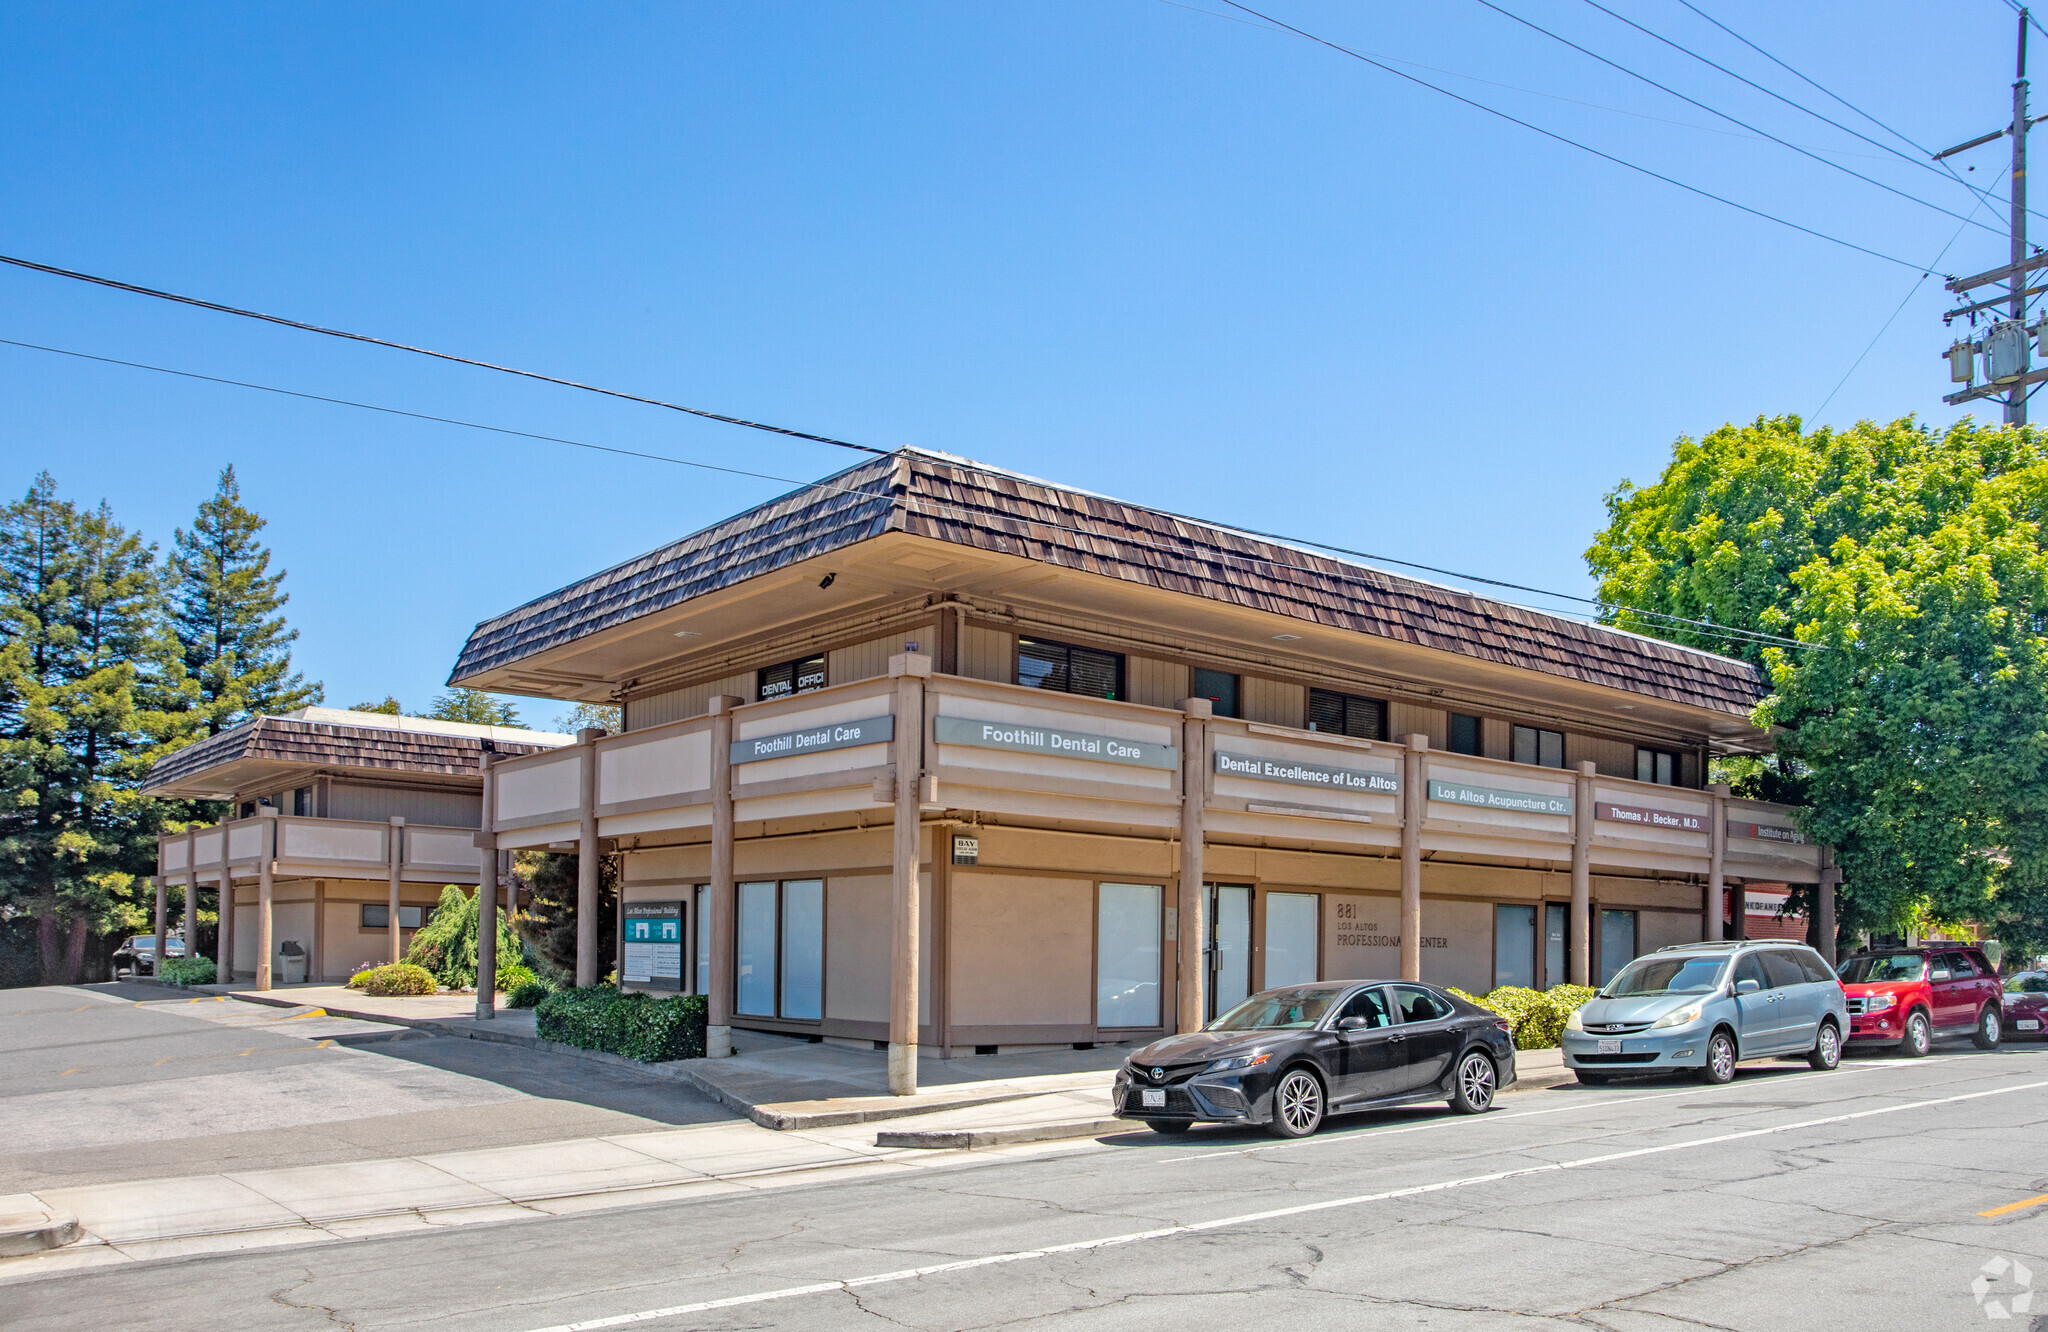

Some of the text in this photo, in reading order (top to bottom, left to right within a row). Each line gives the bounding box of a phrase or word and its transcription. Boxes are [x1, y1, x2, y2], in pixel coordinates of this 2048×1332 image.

[762, 680, 792, 696] DENTAL
[754, 727, 861, 755] Foothill Dental Care
[983, 725, 1141, 759] Foothill Dental Care
[1221, 756, 1397, 791] Dental Excellence of Los Altos
[1438, 786, 1566, 812] Los Altos Acupuncture Ctr.
[1611, 807, 1700, 829] Thomas J. Becker, M.D.
[1757, 825, 1782, 839] Institute
[1782, 831, 1790, 840] on
[1337, 903, 1357, 919] 881
[1337, 922, 1378, 932] LOS ALTOS
[1337, 934, 1448, 948] PROFESSIONA ENTER
